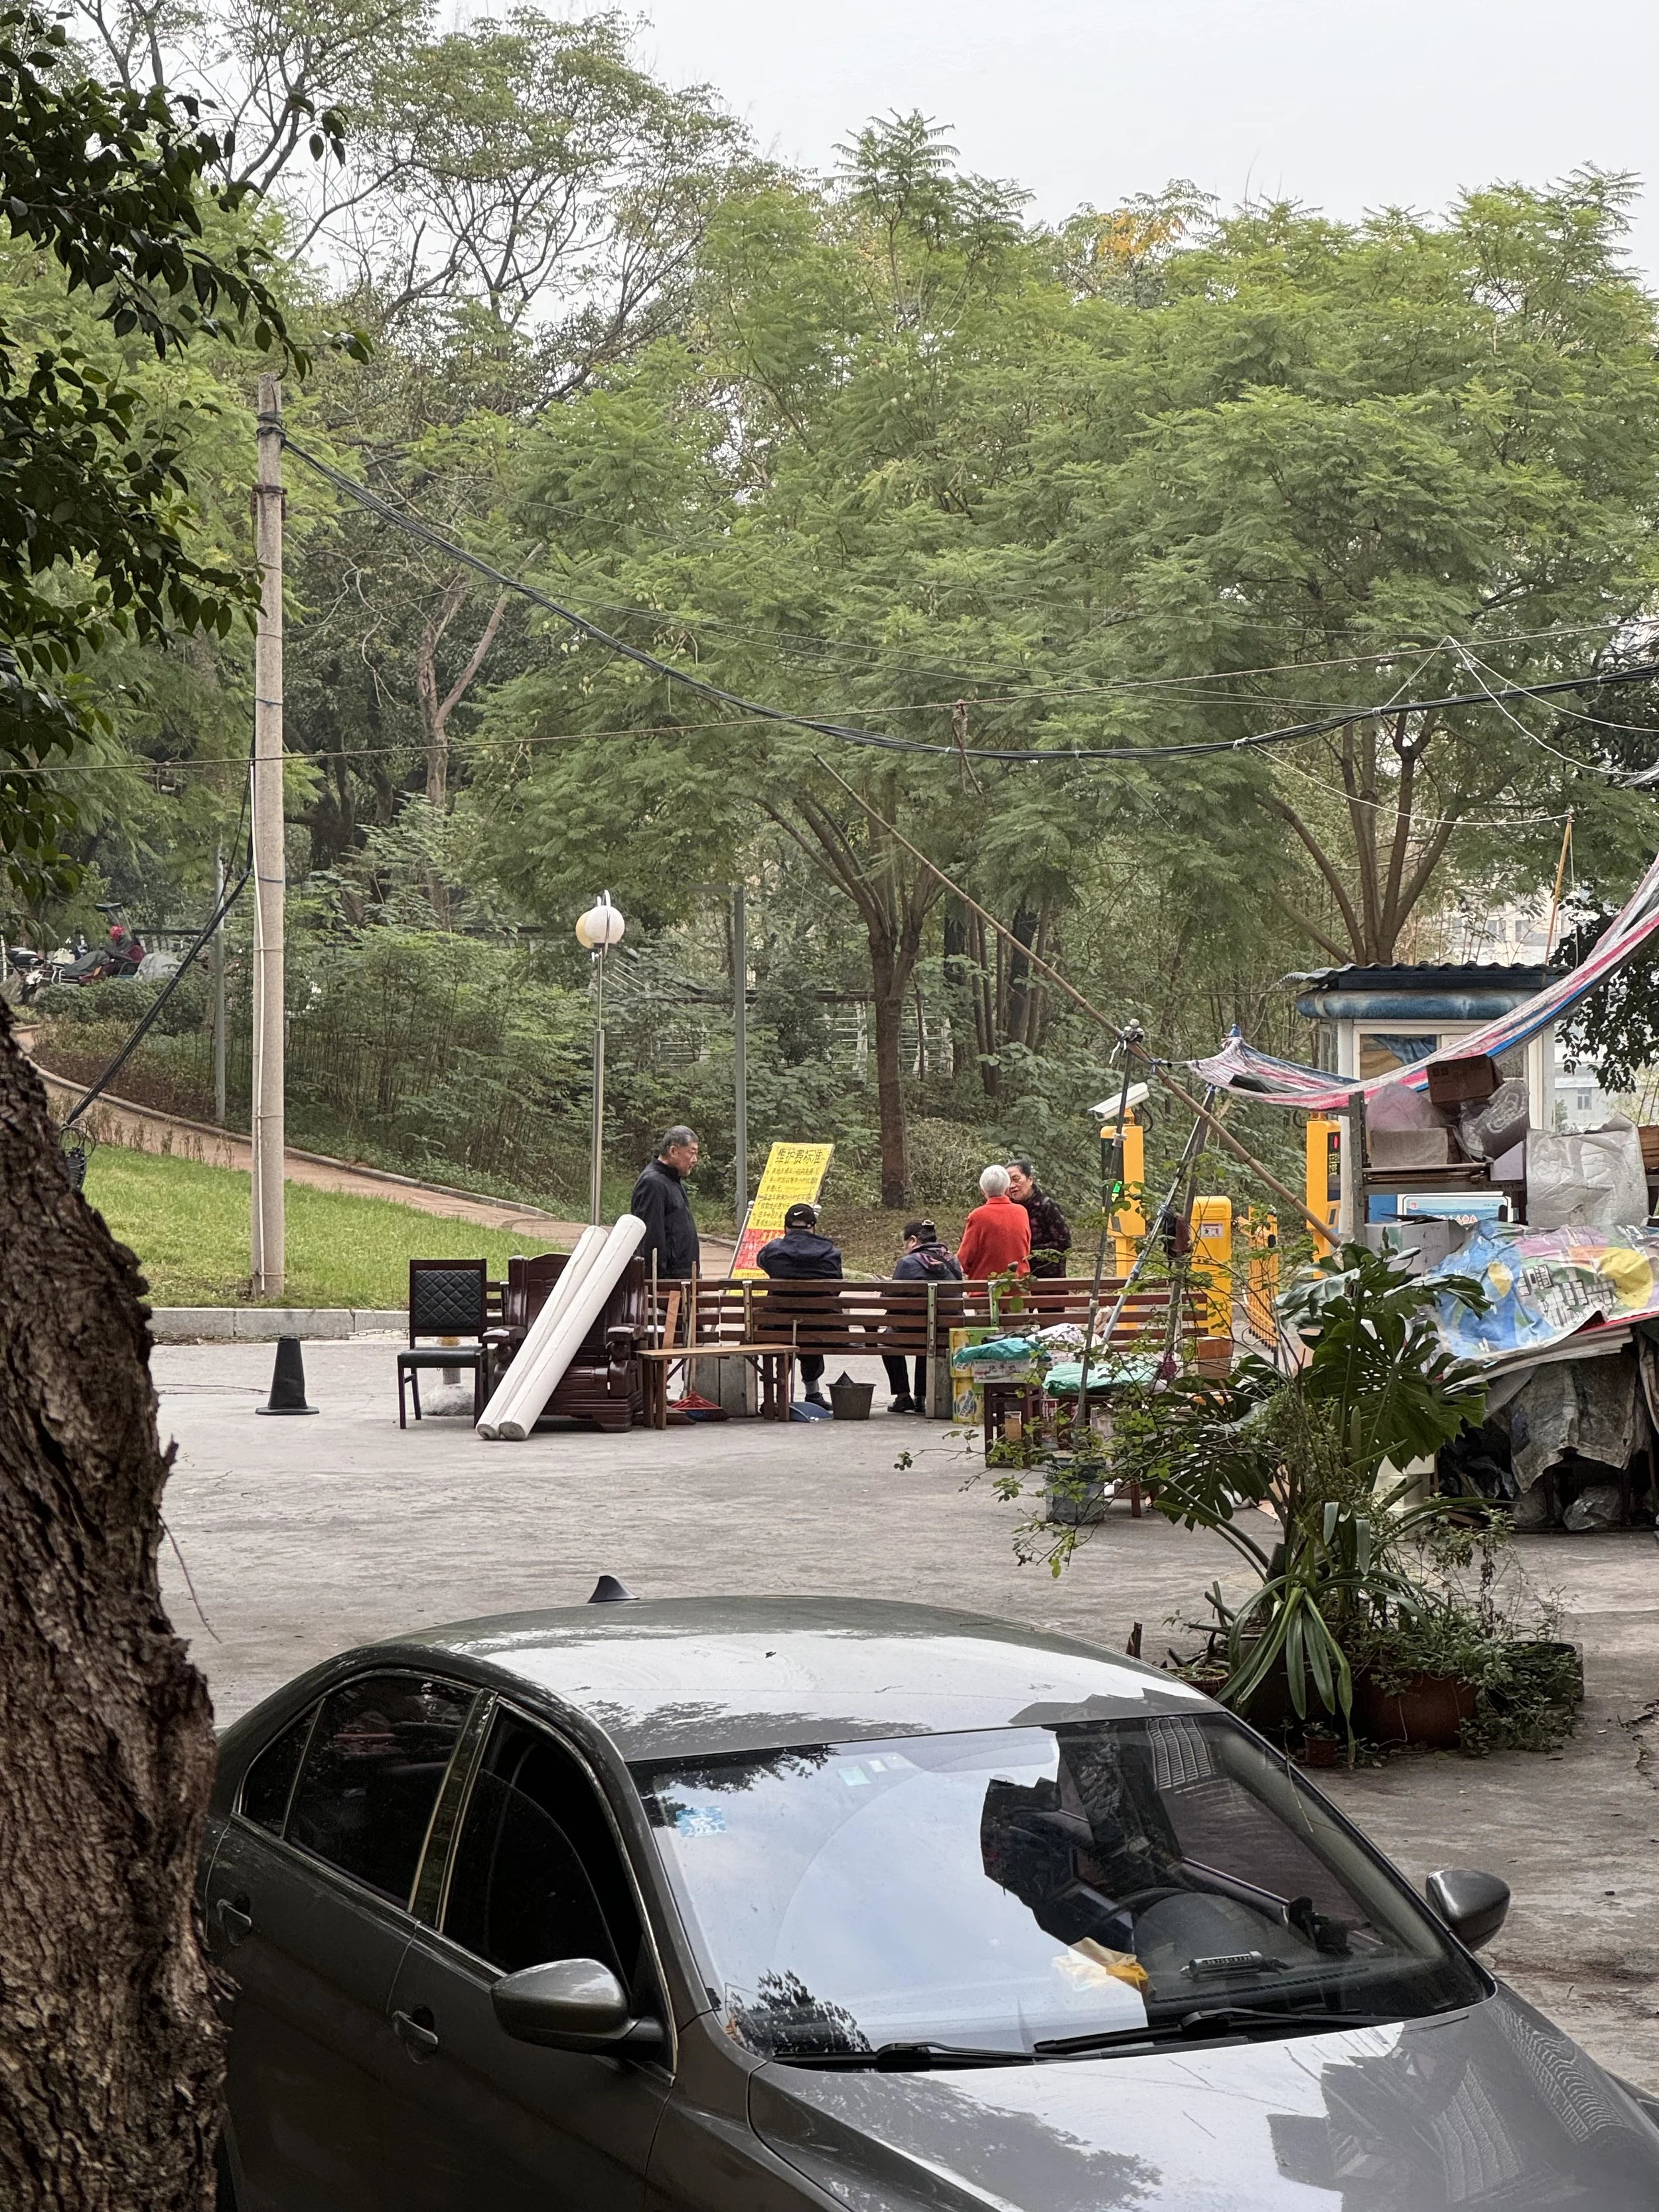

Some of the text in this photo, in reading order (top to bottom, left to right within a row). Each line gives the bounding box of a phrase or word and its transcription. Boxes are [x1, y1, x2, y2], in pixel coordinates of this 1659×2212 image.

[775, 1148, 823, 1164] 维护费标准
